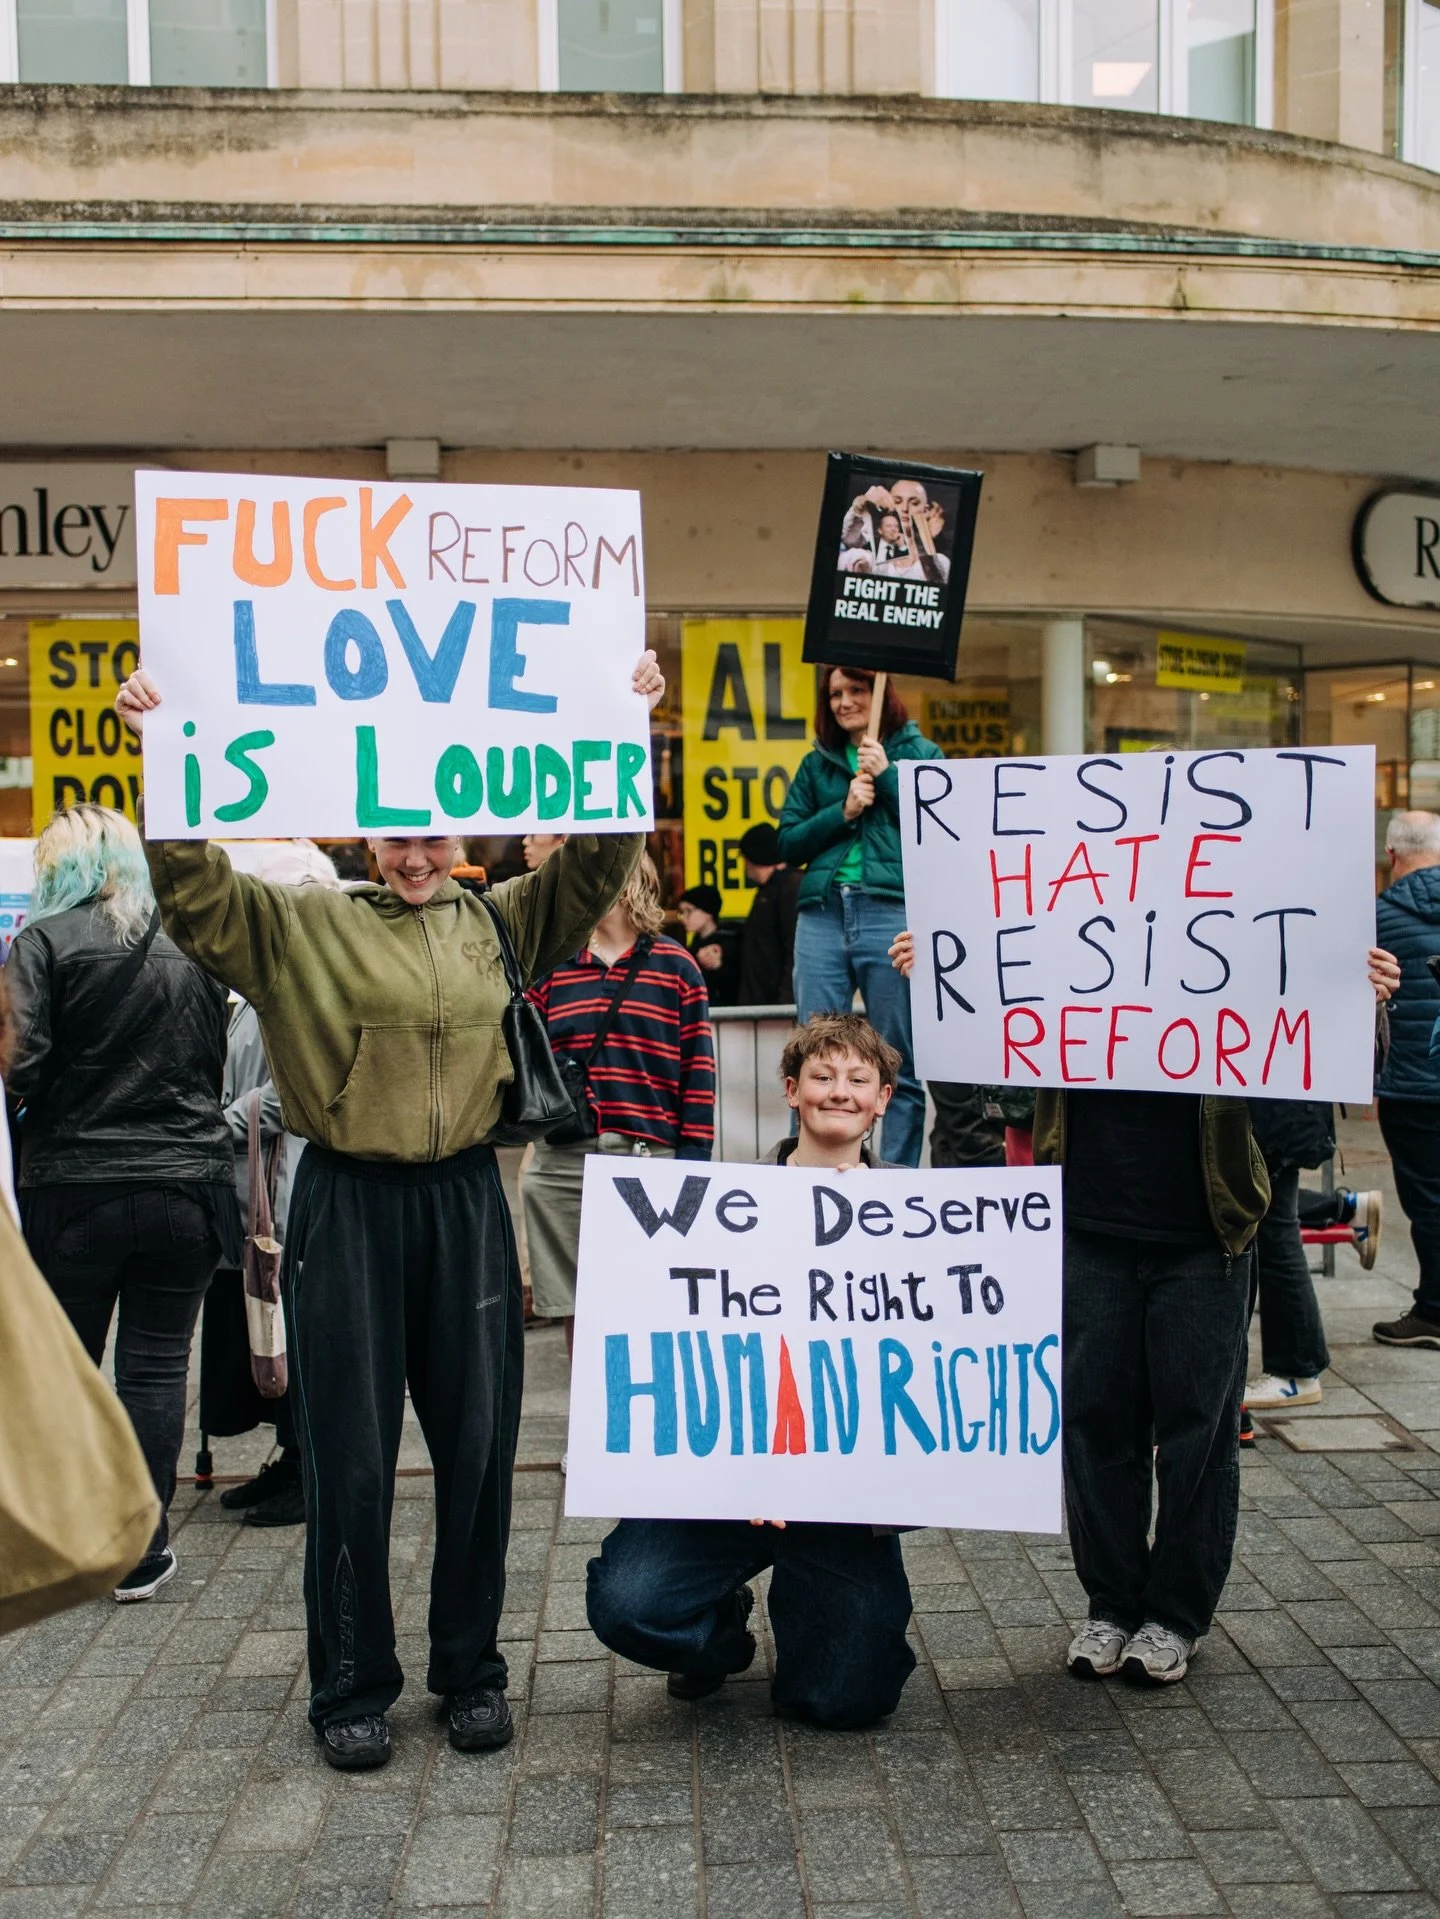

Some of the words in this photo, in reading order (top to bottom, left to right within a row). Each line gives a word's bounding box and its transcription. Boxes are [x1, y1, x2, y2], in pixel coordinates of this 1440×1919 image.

[154, 487, 412, 595] FUCK
[428, 511, 641, 597] REFORM
[834, 599, 880, 622] REAL
[882, 604, 945, 629] ENEMY
[843, 576, 901, 602] FIGHT
[904, 583, 941, 607] THE
[233, 597, 571, 714] LOVE
[702, 642, 822, 741] AL
[53, 773, 143, 815] DO
[355, 724, 647, 829] LOUDER
[699, 838, 758, 890] RE
[989, 833, 1242, 918] HATE
[1003, 1004, 1312, 1091] REFORM
[612, 1175, 758, 1239] We
[812, 1185, 1052, 1247] Deserve
[668, 1267, 782, 1318] The
[808, 1268, 934, 1322] Right
[946, 1263, 1005, 1316] To
[604, 1330, 861, 1458] HUMAN
